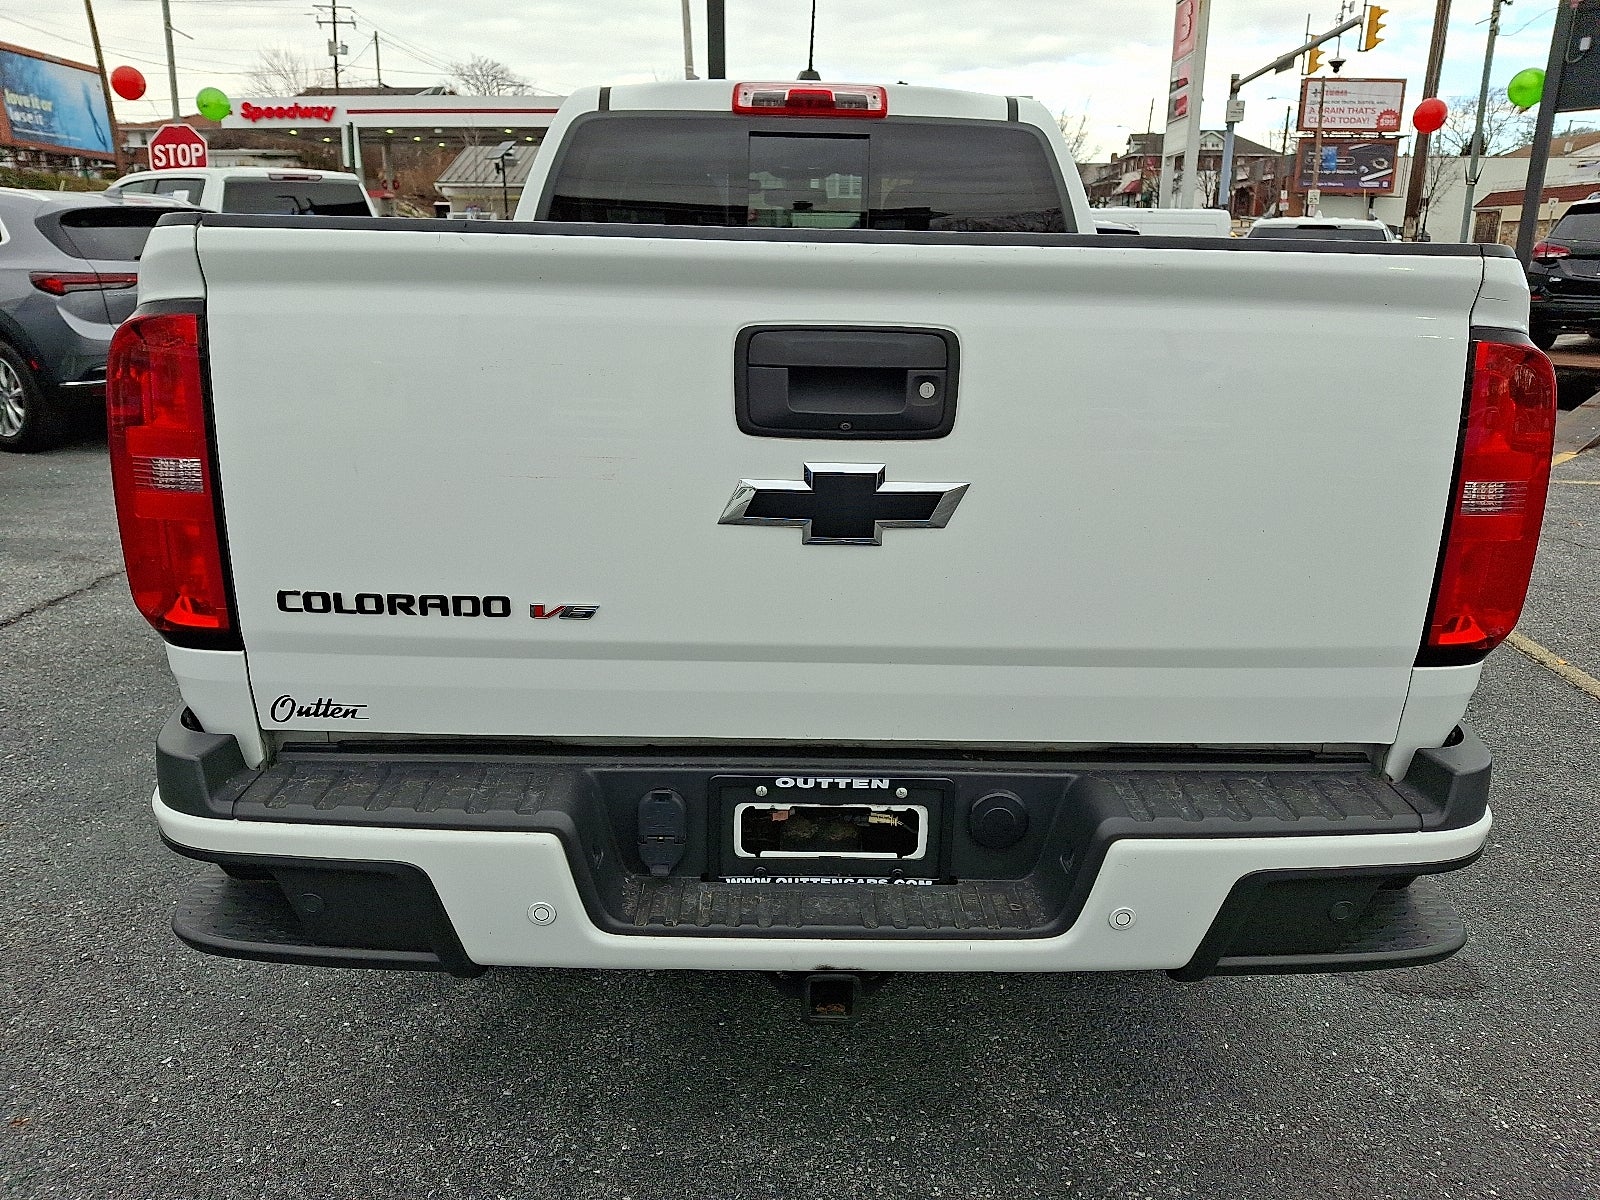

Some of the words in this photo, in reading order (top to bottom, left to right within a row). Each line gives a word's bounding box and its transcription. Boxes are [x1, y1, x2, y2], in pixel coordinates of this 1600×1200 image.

[241, 102, 336, 122] Speedway
[1308, 116, 1336, 124] CLAR
[153, 143, 204, 167] STOP
[276, 589, 511, 618] COLORADO
[529, 603, 600, 620] V6
[270, 694, 369, 722] Outten
[775, 777, 889, 789] OUTTEN
[725, 877, 933, 886] WWWOUTTENCARSCOM
